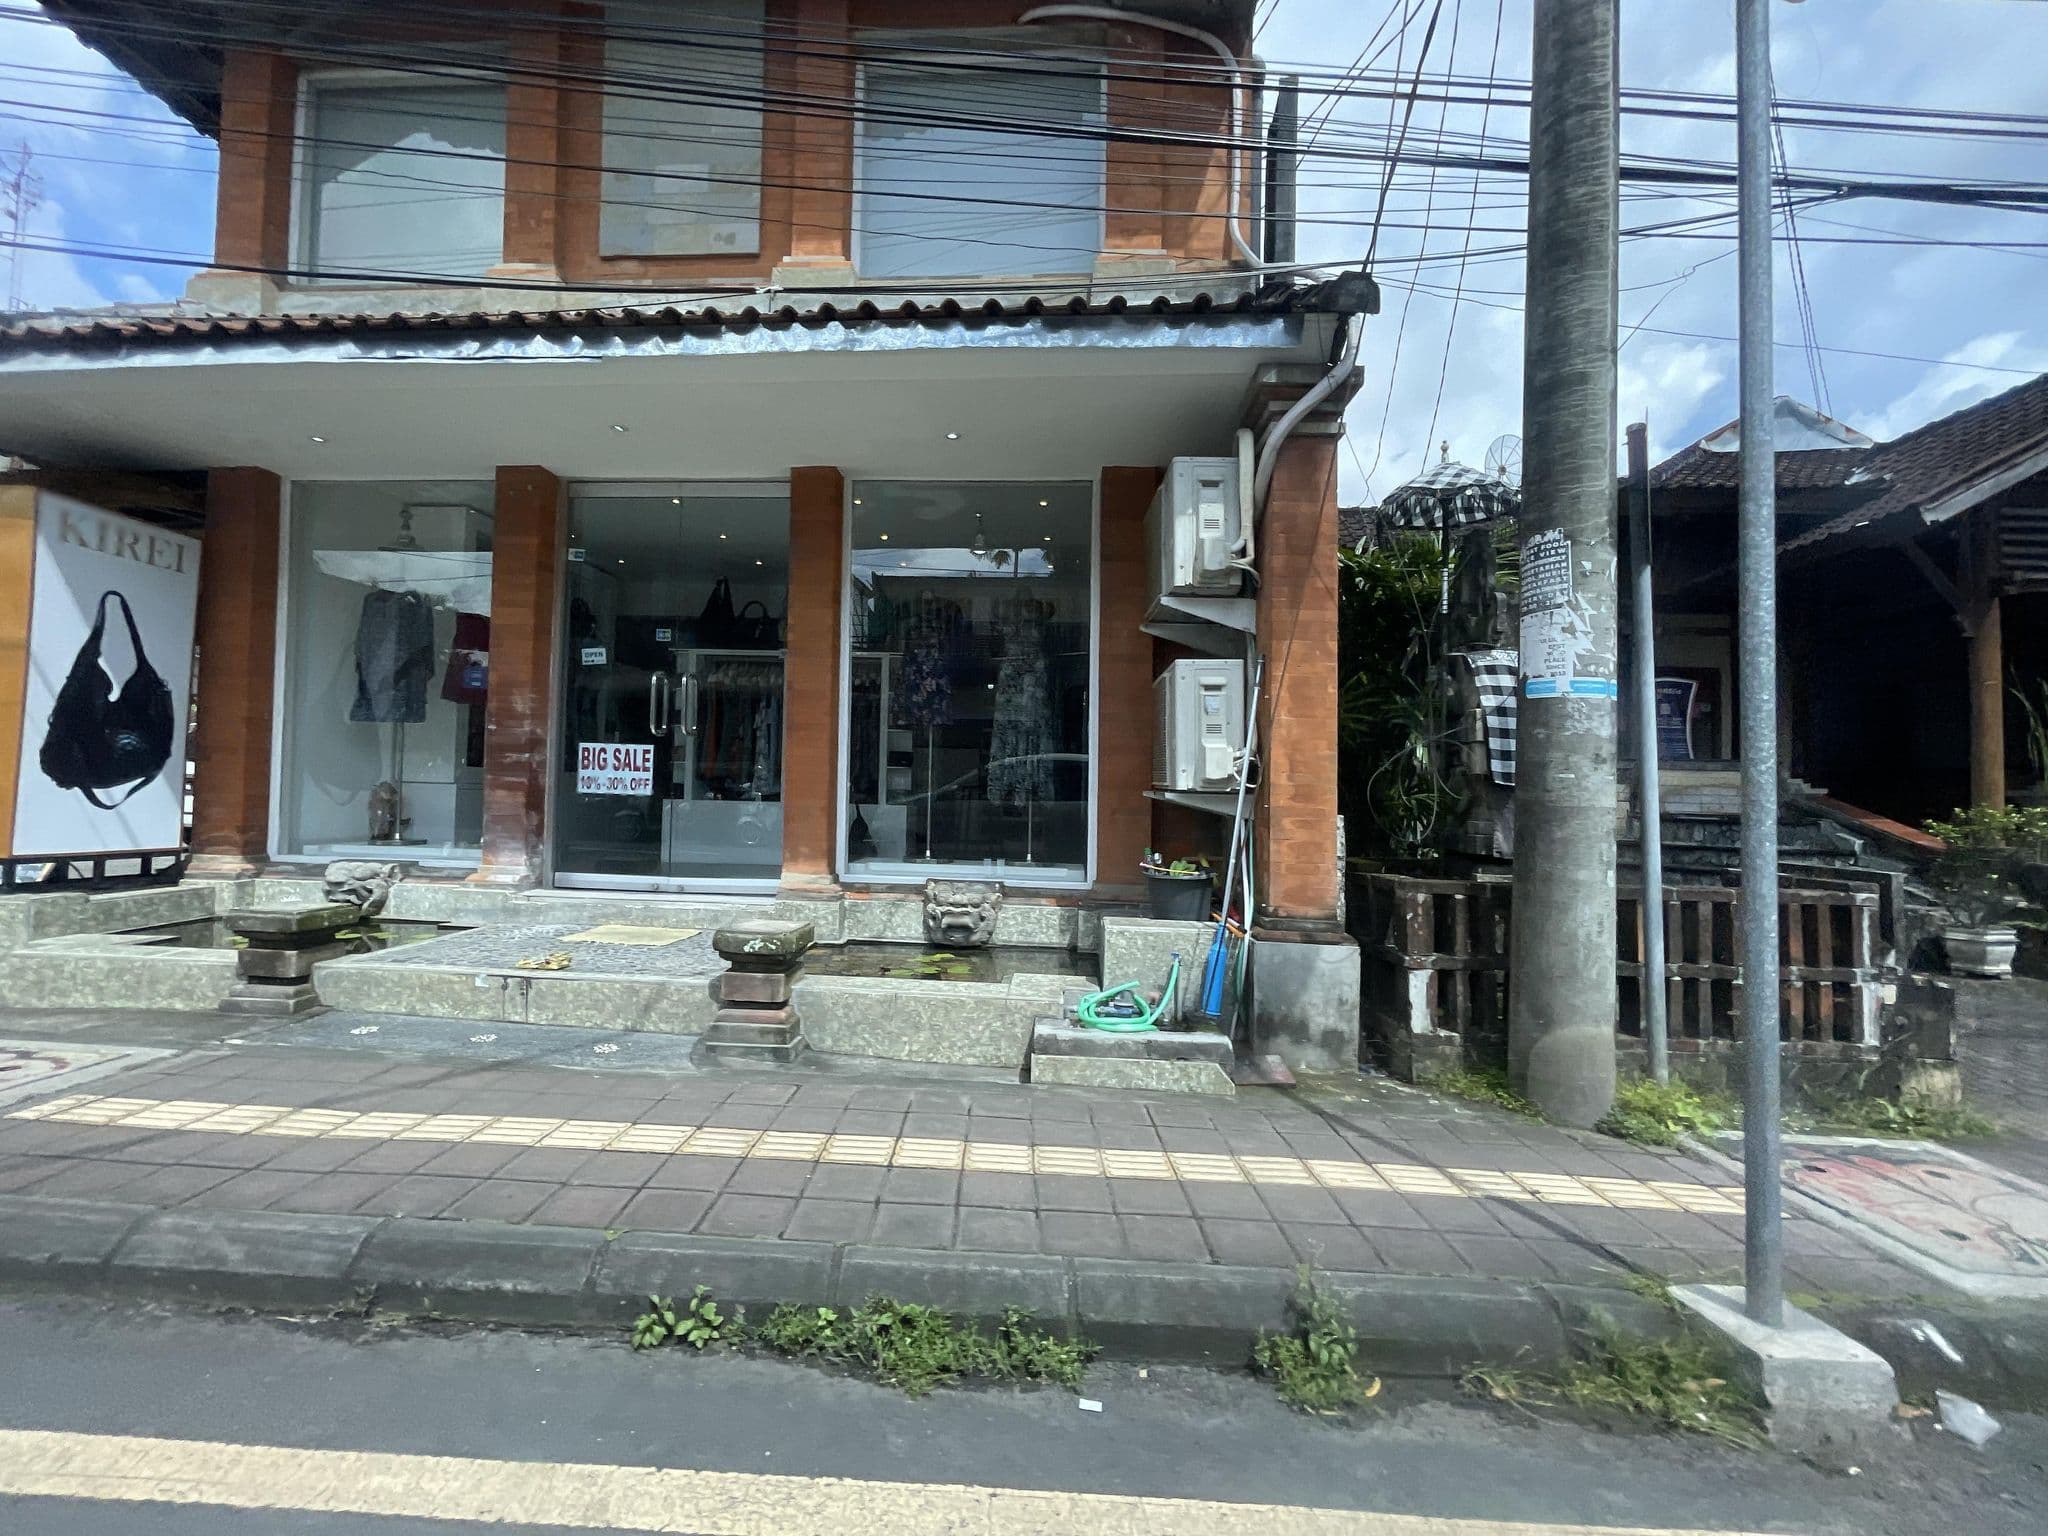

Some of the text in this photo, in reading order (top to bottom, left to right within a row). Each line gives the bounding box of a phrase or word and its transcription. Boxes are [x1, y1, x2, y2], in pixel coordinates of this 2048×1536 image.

[59, 511, 185, 574] KIREI
[1539, 547, 1566, 558] VIEW
[581, 747, 651, 772] BIG SALE
[630, 777, 650, 790] OFF
